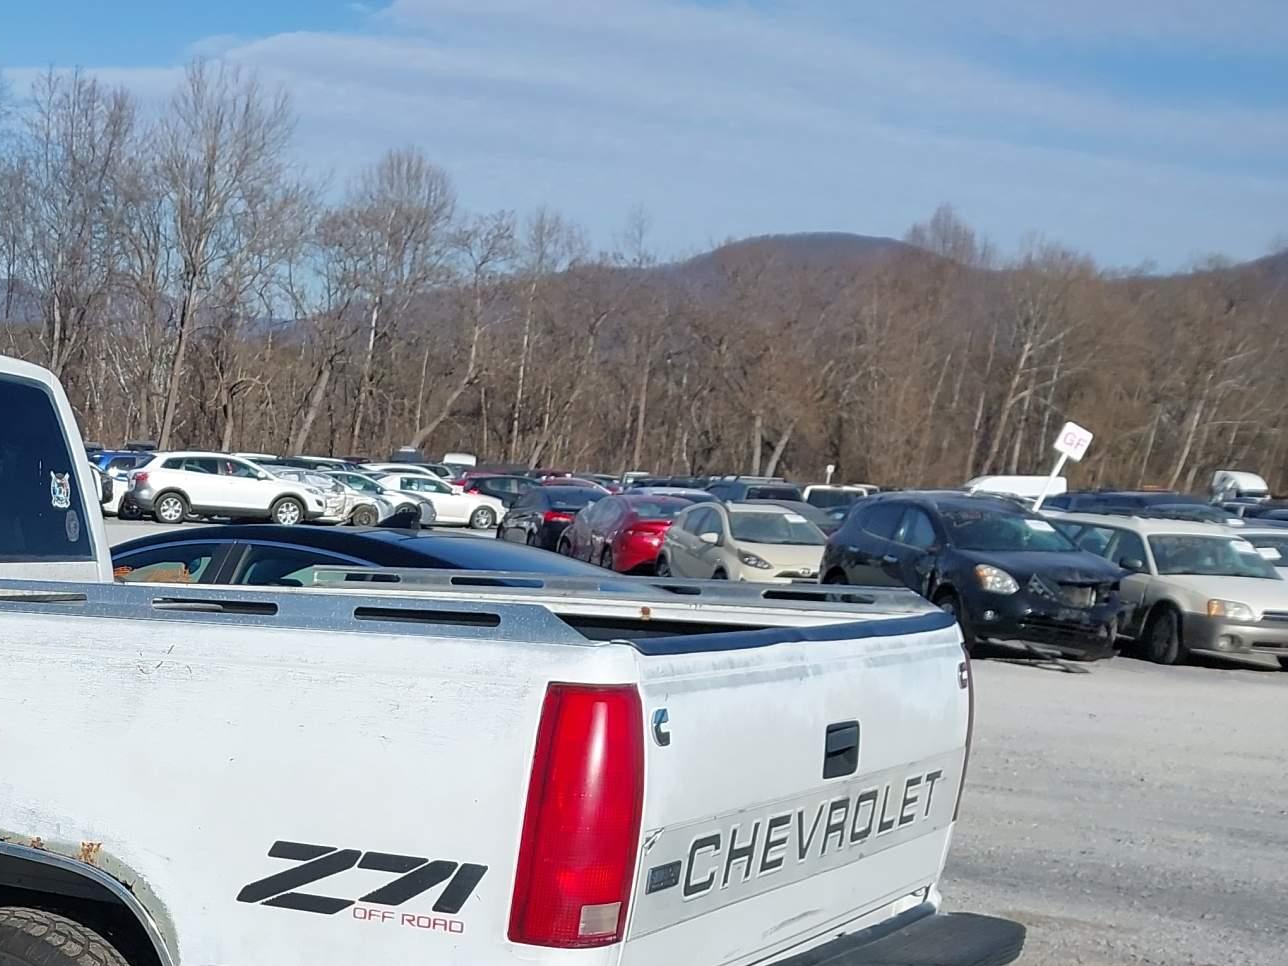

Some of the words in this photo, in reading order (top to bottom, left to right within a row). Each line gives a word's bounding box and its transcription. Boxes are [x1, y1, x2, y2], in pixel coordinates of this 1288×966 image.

[682, 769, 943, 898] CHEVROLET
[236, 840, 489, 915] Z71
[352, 906, 396, 923] OFF
[400, 913, 465, 934] ROAD
